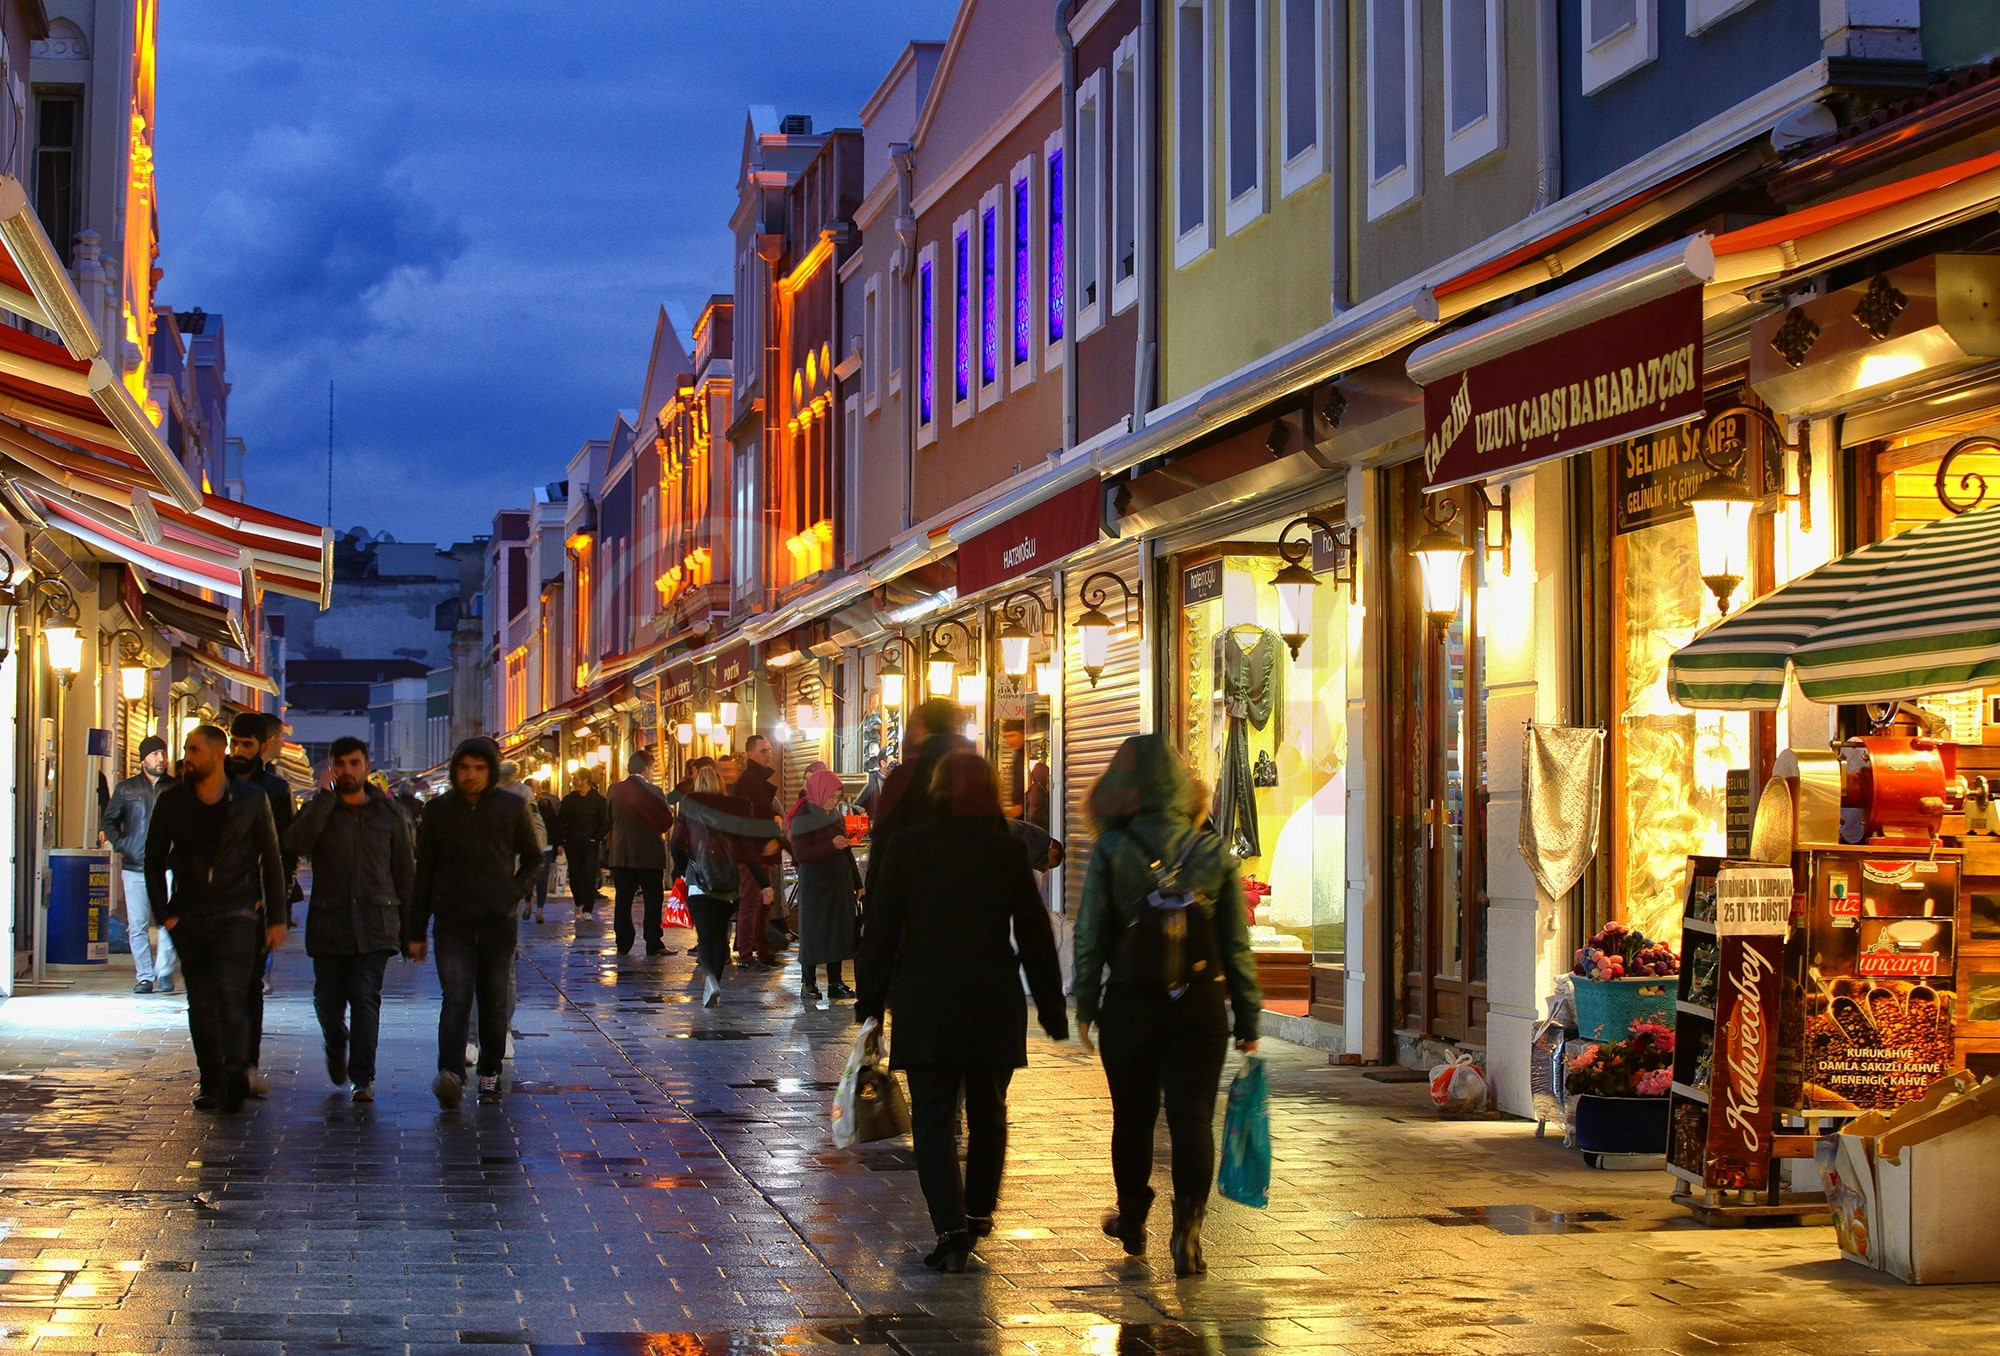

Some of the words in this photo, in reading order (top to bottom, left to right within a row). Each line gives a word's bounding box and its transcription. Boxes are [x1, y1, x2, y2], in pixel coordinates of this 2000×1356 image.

[1423, 370, 1472, 483] TARİHİ
[1474, 402, 1515, 455] UZUN
[1519, 391, 1568, 453] ÇARŞI
[1626, 438, 1679, 479] SELMA
[1627, 480, 1663, 514] GELİNLİK
[1668, 476, 1677, 509] İÇ
[1003, 536, 1036, 569] HATEMOĞLU
[1190, 564, 1217, 590] hatemoğlu
[723, 659, 740, 683] POTİN
[1718, 876, 1748, 898] MORİNGA
[1748, 878, 1758, 897] DA
[1758, 878, 1793, 898] KAMPANYA
[1724, 902, 1735, 923] 25
[1736, 902, 1746, 922] TL
[1760, 899, 1789, 926] DÜŞTÜ
[1726, 940, 1774, 1152] Kahvecibey
[1846, 1048, 1914, 1058] KURUKAHVE
[1819, 1061, 1858, 1071] DAMLA
[1860, 1062, 1901, 1072] SAKIZLI
[1903, 1063, 1940, 1073] KAHVE
[1831, 1074, 1888, 1087] MENENGİÇ
[1890, 1076, 1927, 1086] KAHVE
